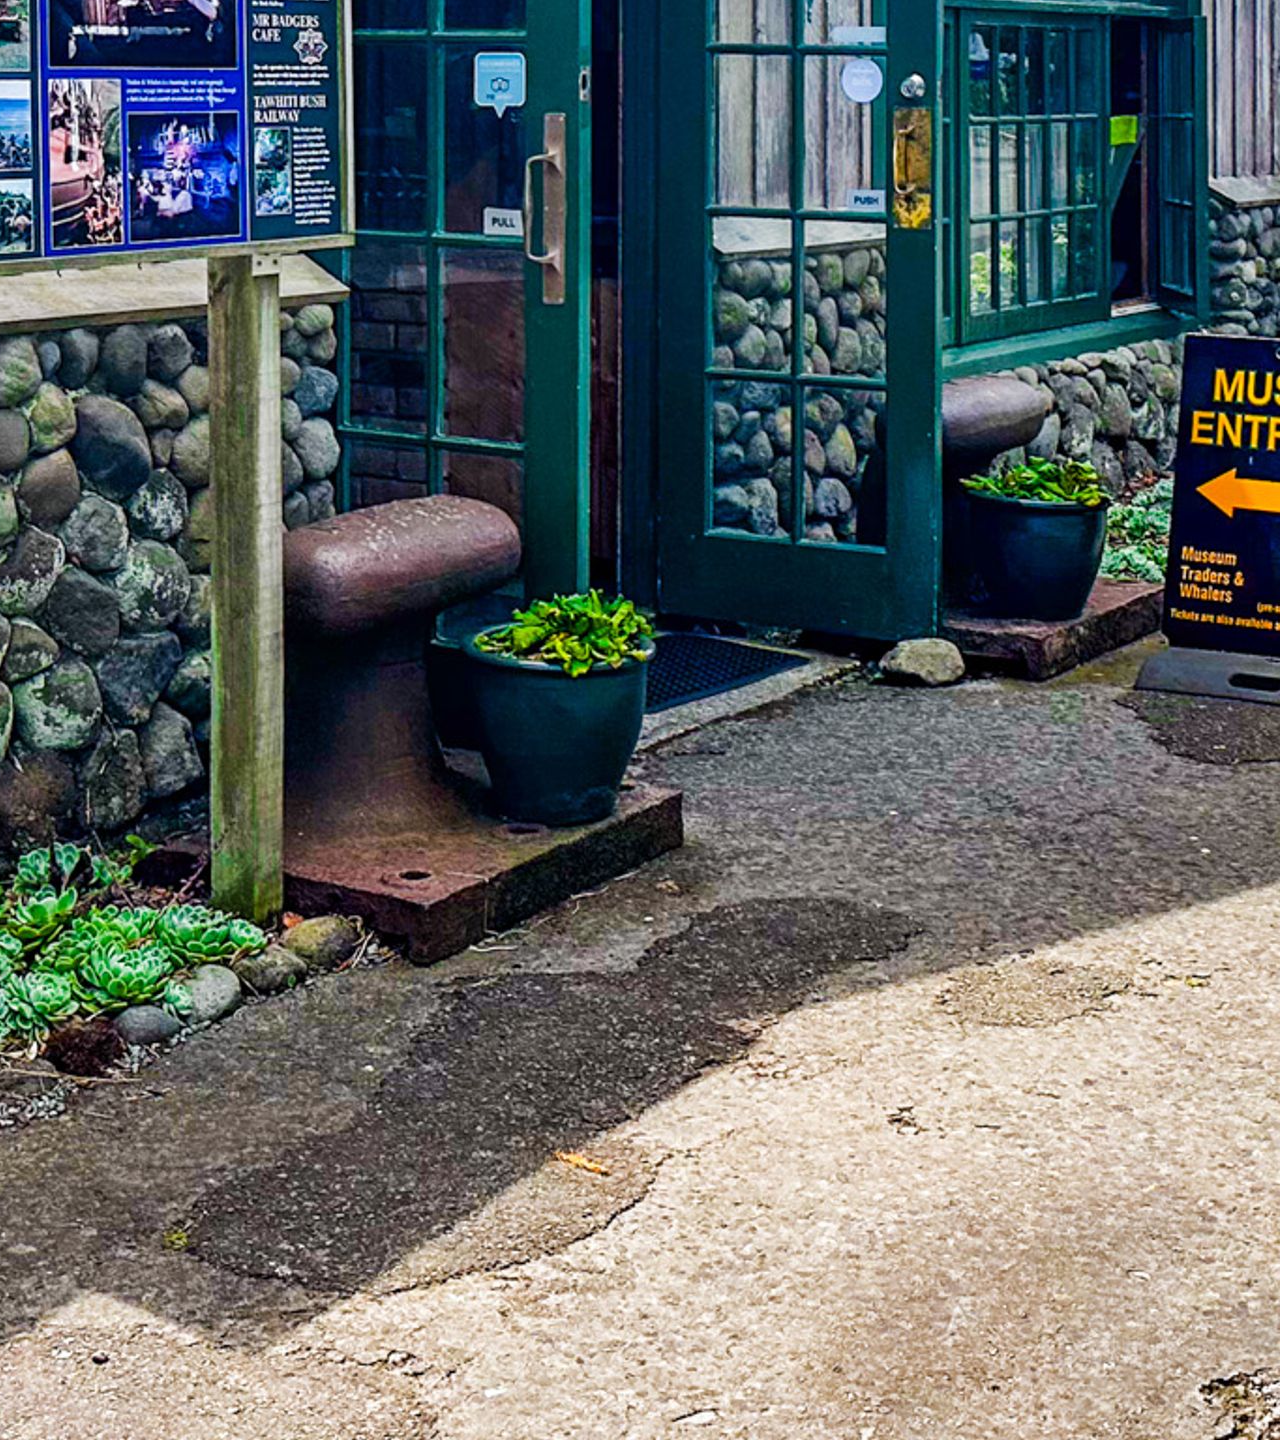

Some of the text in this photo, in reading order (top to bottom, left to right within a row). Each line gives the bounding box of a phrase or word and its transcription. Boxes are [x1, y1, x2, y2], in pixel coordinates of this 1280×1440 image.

[252, 13, 320, 28] MR BADGERS
[252, 28, 281, 42] CAFE
[253, 94, 327, 108] TAWHITI BUSH
[254, 109, 300, 123] RAILWAY
[854, 195, 879, 205] PUSH
[491, 216, 515, 228] PULL
[1181, 546, 1237, 567] Museum
[1180, 565, 1230, 586] Traders
[1233, 572, 1245, 587] &
[1179, 582, 1233, 604] Whalers
[1170, 607, 1200, 621] Tickets
[1200, 613, 1215, 623] are
[1216, 614, 1234, 625] also
[1235, 616, 1273, 630] available
